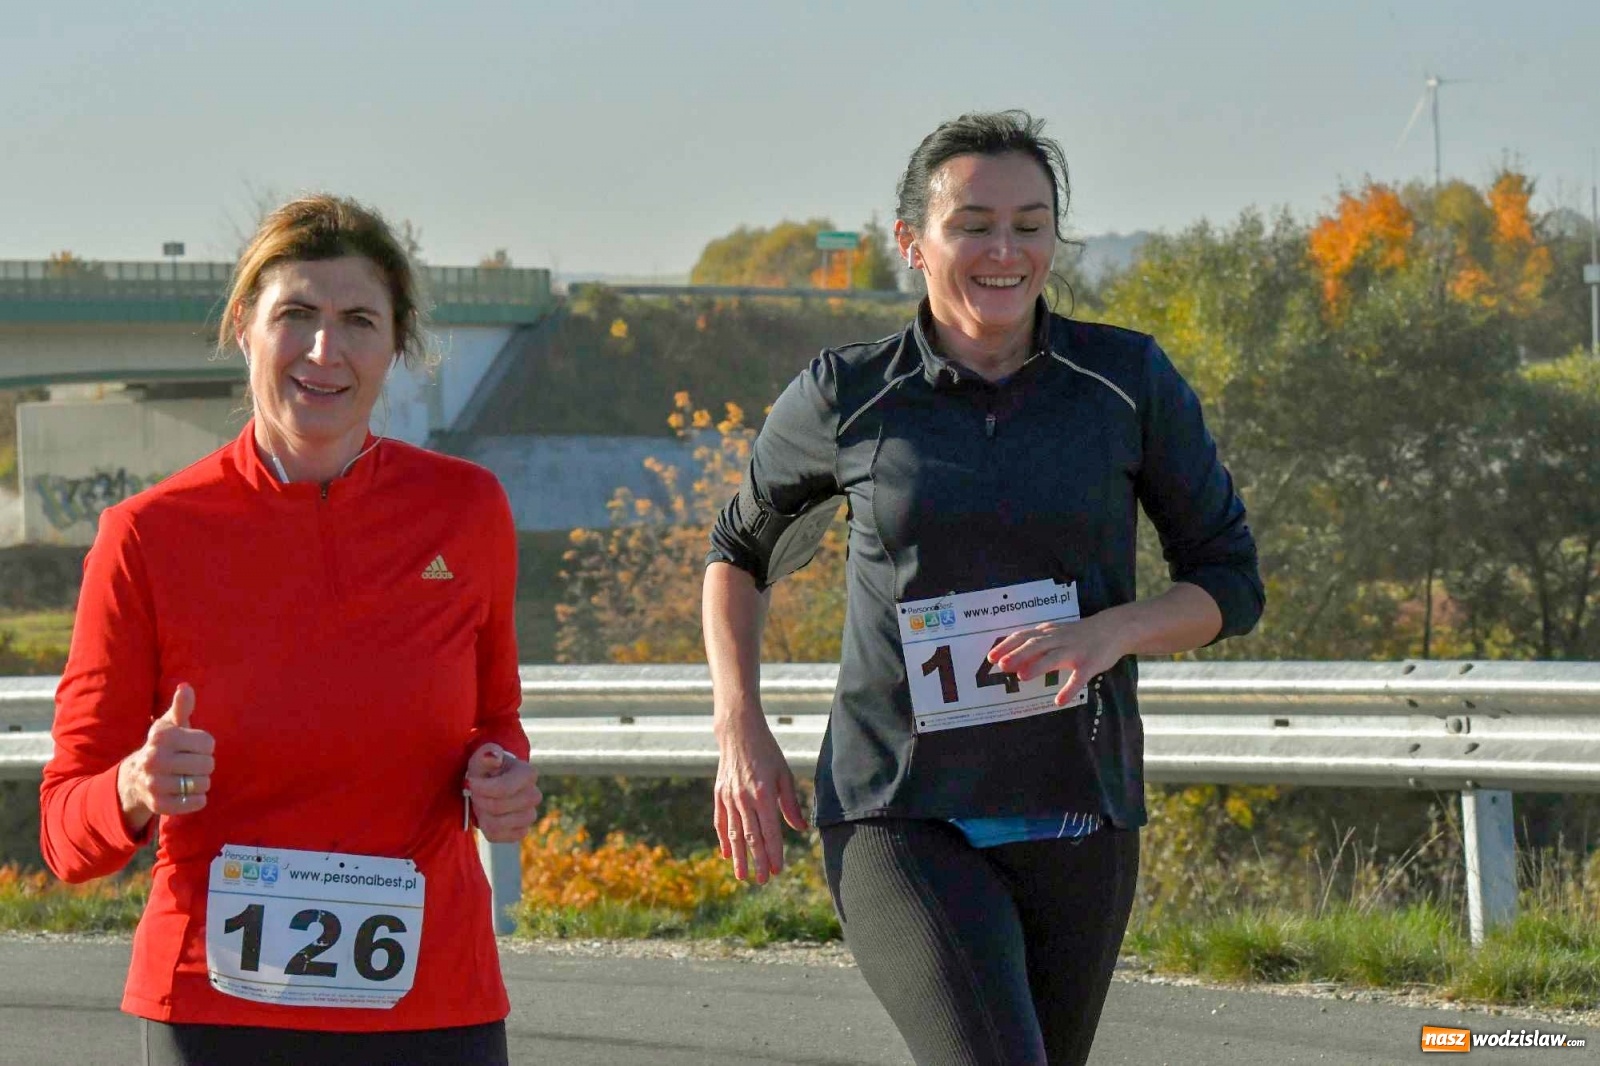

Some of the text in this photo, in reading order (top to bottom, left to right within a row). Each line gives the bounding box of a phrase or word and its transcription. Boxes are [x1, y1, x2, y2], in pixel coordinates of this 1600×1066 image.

[421, 570, 454, 580] adidas
[963, 591, 1071, 618] www.personalbest.pl
[921, 636, 1060, 704] 14
[290, 870, 417, 891] www.personalbest.pl
[223, 903, 408, 982] 126
